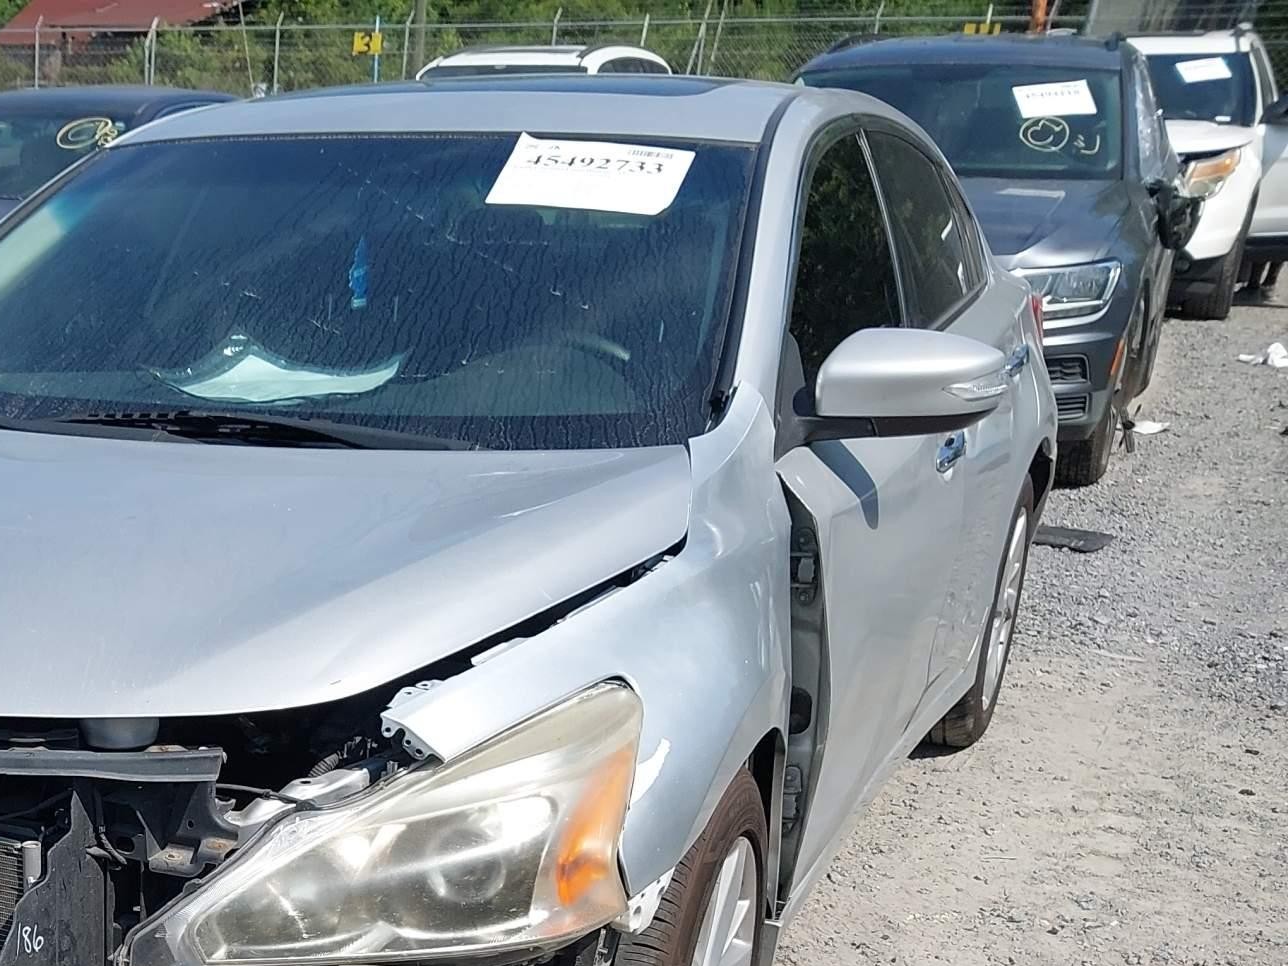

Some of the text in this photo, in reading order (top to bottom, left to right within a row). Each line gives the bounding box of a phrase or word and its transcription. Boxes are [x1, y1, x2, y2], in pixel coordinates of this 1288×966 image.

[358, 32, 372, 54] 3
[526, 154, 664, 175] 45492733
[14, 922, 45, 960] 186
